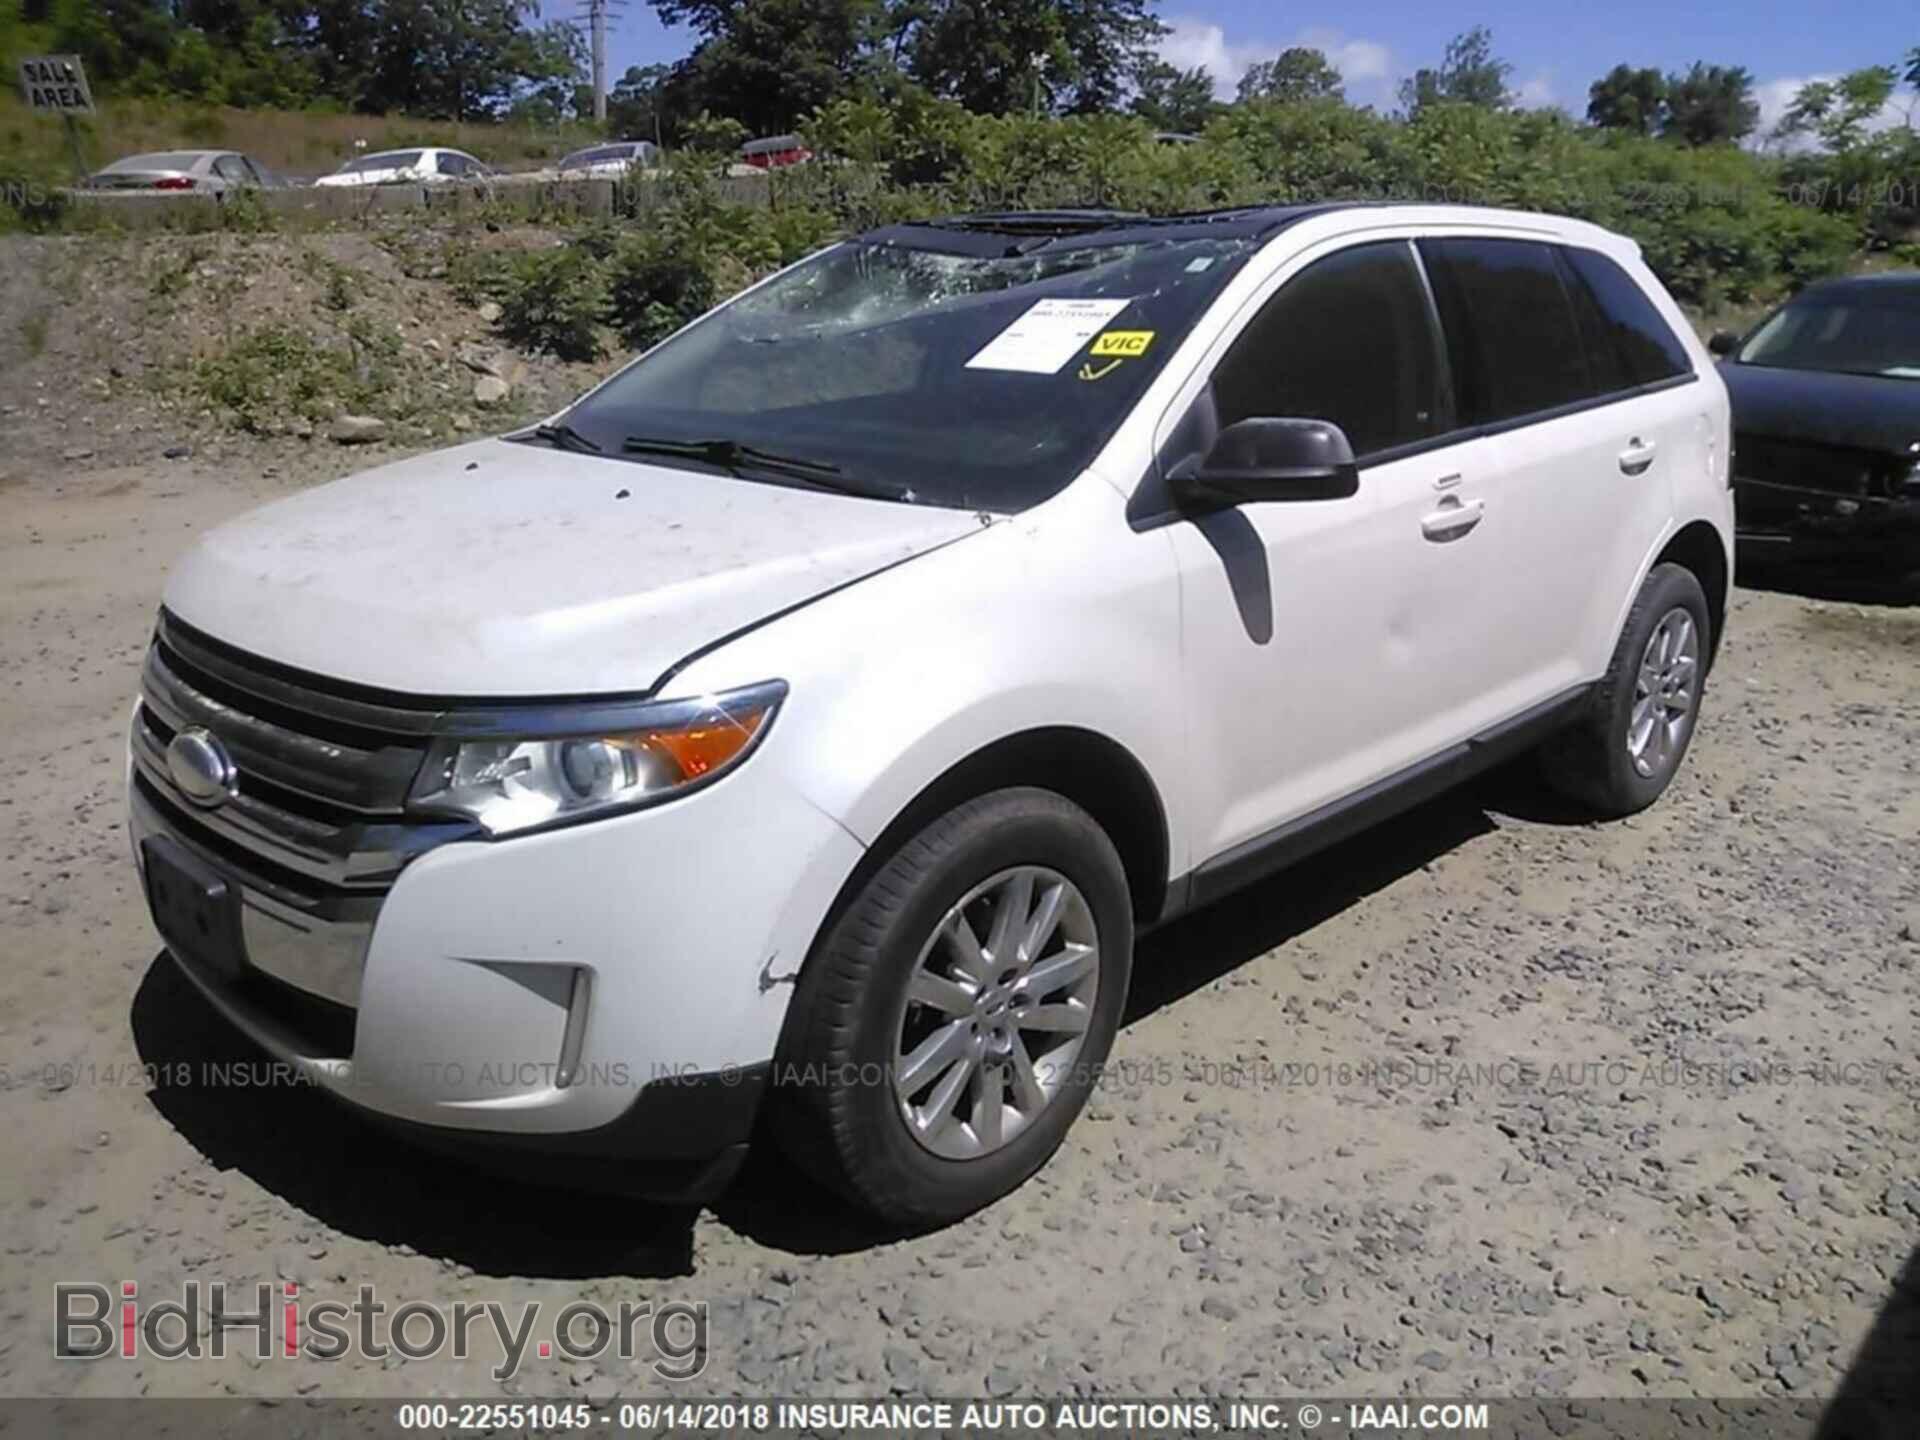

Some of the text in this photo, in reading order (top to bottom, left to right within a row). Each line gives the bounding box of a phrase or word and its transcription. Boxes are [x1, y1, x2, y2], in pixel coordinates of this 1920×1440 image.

[24, 62, 77, 83] SALE
[32, 87, 89, 108] AREA
[1102, 336, 1145, 351] VIC
